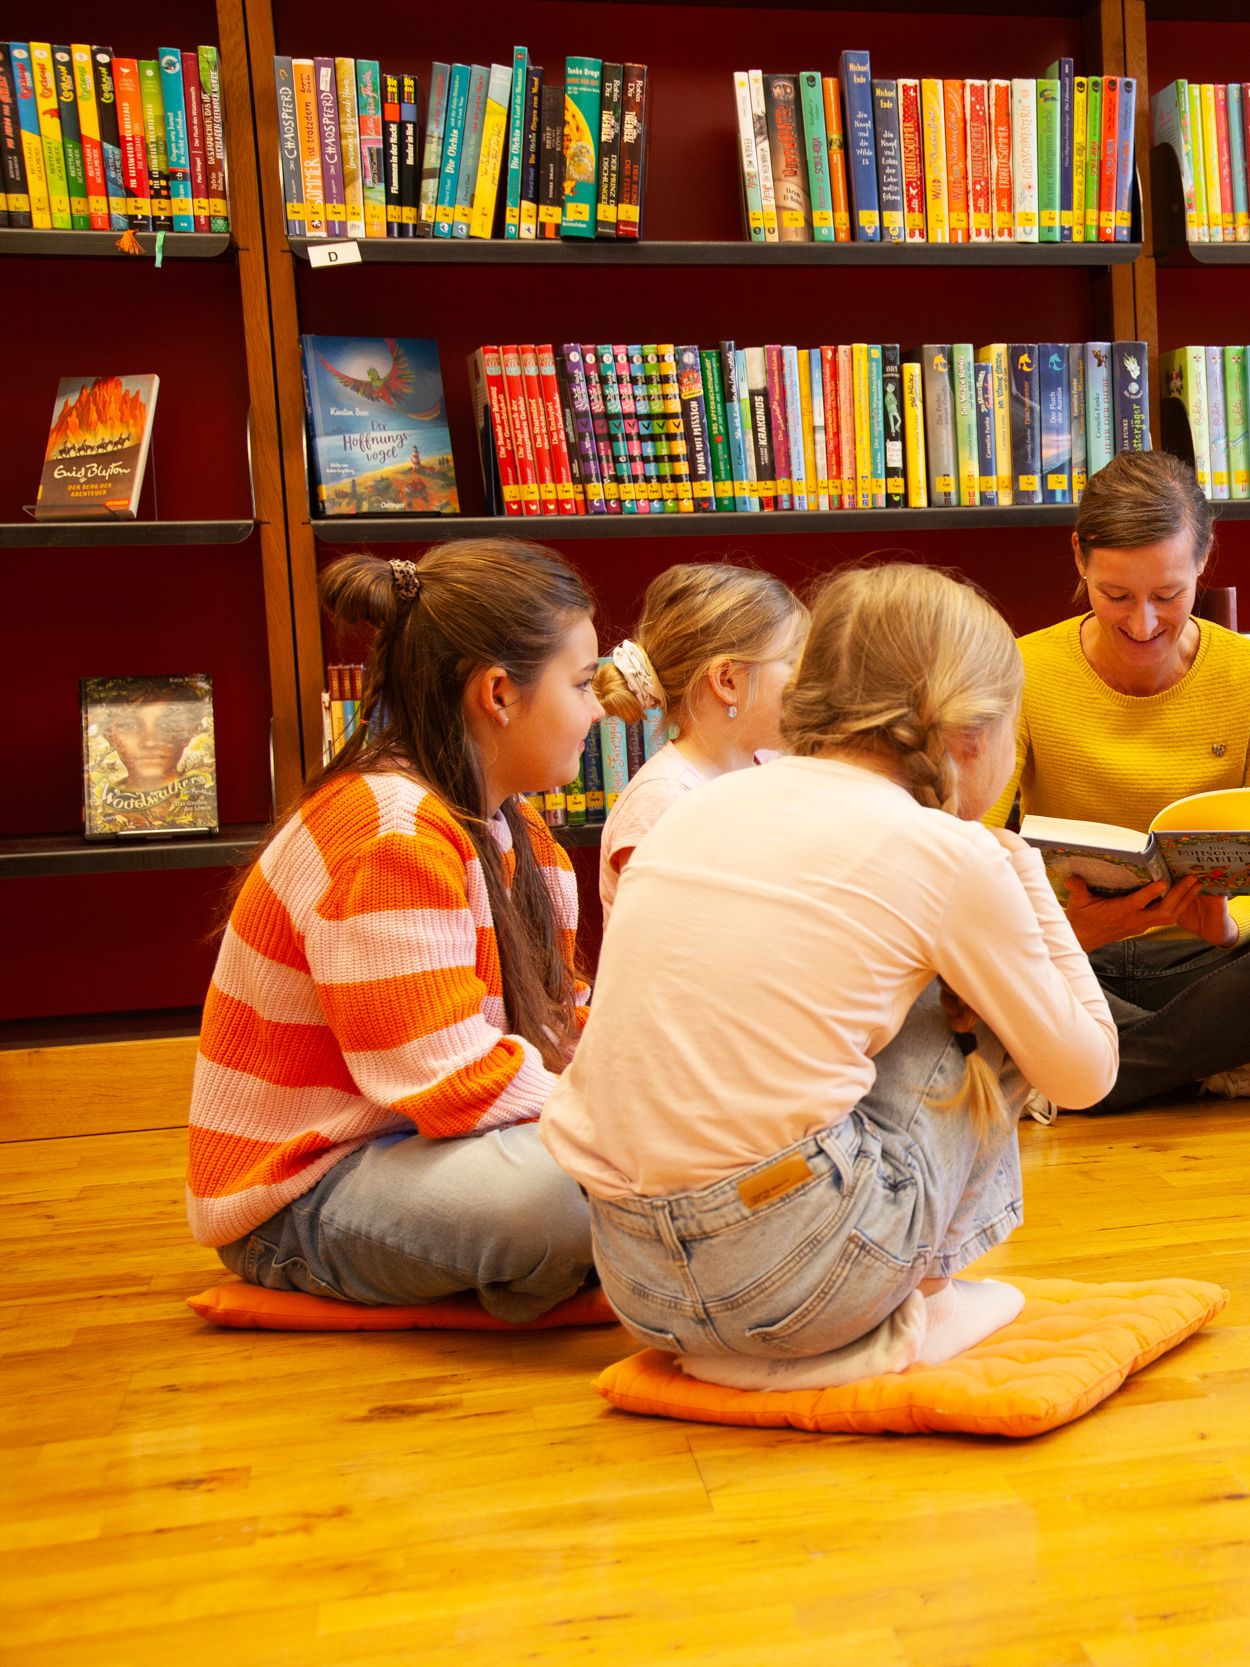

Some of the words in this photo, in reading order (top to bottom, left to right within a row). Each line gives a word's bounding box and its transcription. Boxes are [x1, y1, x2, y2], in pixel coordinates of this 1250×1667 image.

[567, 67, 583, 76] Tonke
[584, 68, 600, 78] Dragt
[848, 62, 869, 73] Michael
[853, 75, 866, 84] Ende
[604, 83, 613, 97] Dix
[612, 80, 621, 102] Robin
[627, 83, 636, 98] Dix
[635, 80, 643, 102] Robin
[875, 87, 896, 98] Michael
[880, 100, 893, 109] Ende
[854, 120, 872, 131] Knopf
[511, 129, 522, 154] Olchis
[880, 139, 898, 149] Knopf
[445, 158, 455, 174] Die
[510, 156, 520, 169] Die
[329, 251, 338, 263] D
[1049, 391, 1057, 410] Fluch
[690, 400, 702, 436] MISSION
[754, 395, 768, 446] KRAKONOS
[371, 420, 387, 432] Der
[343, 431, 409, 452] Hoffnungs
[693, 437, 701, 451] MIT
[366, 447, 399, 462] vogel
[53, 464, 86, 479] Enid
[86, 461, 131, 480] Blyton
[101, 774, 207, 810] Woodwalkers
